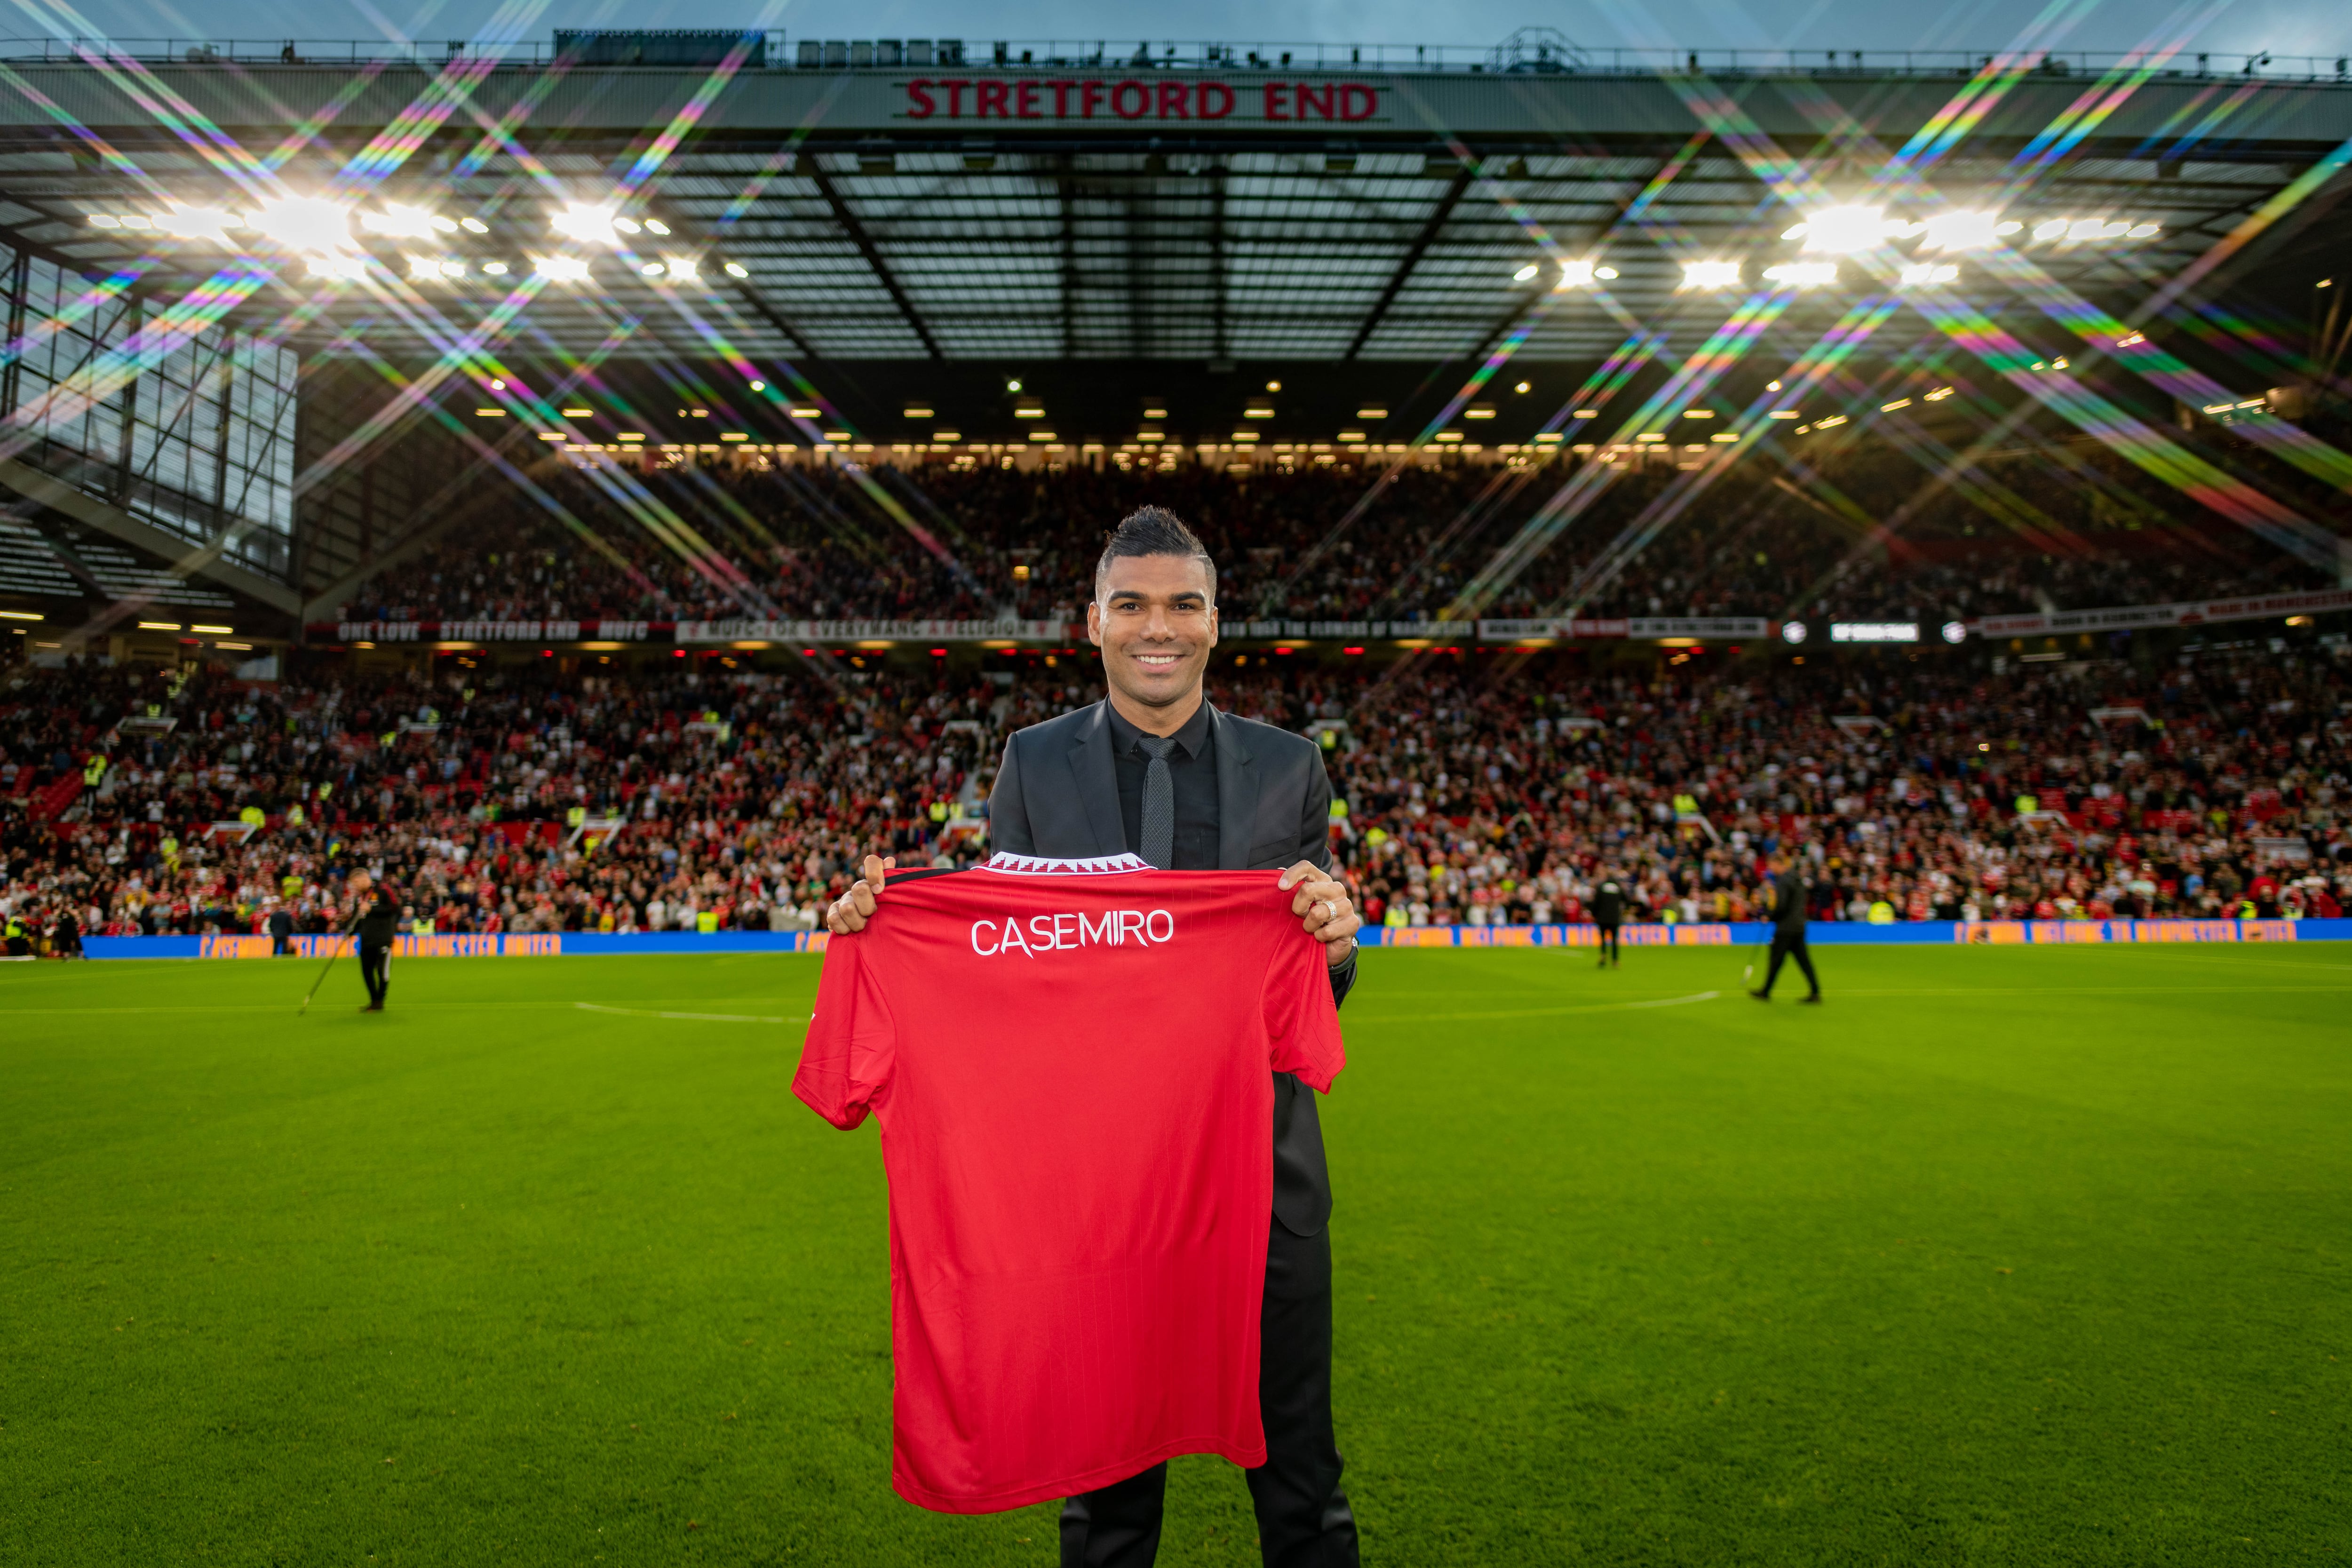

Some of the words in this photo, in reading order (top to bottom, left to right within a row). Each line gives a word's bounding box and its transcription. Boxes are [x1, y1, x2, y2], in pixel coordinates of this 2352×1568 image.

[906, 79, 1235, 120] STRETFORD
[1265, 83, 1378, 121] END
[337, 621, 373, 641] ONE
[377, 621, 420, 641] LOVE
[439, 621, 542, 640] STRETFORD
[545, 621, 580, 640] END
[597, 621, 649, 640] MUFC
[971, 909, 1173, 958] CASEMIRO
[200, 936, 274, 958] CASEMIRO
[391, 934, 497, 957] MANCHESTER
[504, 934, 561, 956] UNITED
